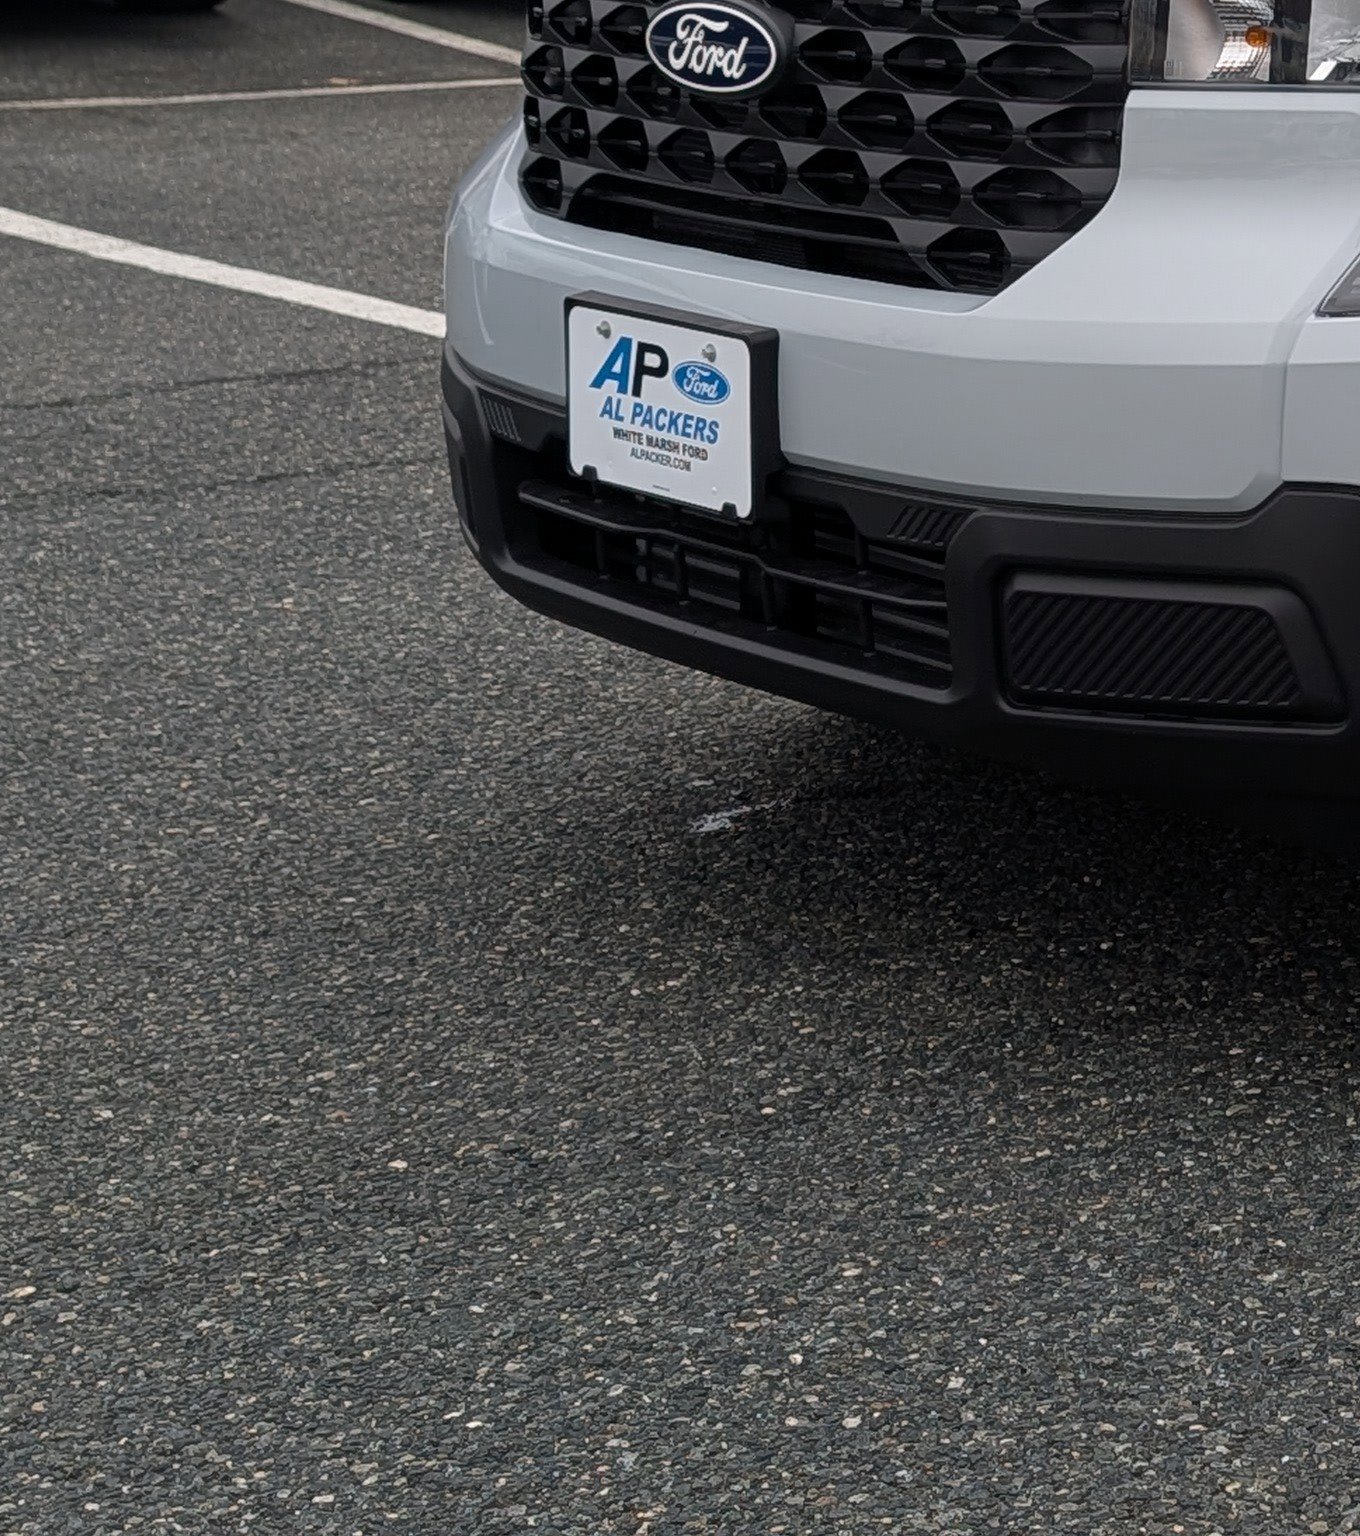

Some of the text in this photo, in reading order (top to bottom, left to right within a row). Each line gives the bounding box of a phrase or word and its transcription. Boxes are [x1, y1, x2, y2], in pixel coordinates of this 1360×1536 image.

[667, 13, 750, 80] Ford
[588, 335, 670, 398] AP
[683, 366, 719, 400] Ford
[599, 395, 720, 445] AL PACKERS
[612, 426, 709, 461] WHITE MARSH FORD
[629, 447, 692, 472] ALPACKER.COM
